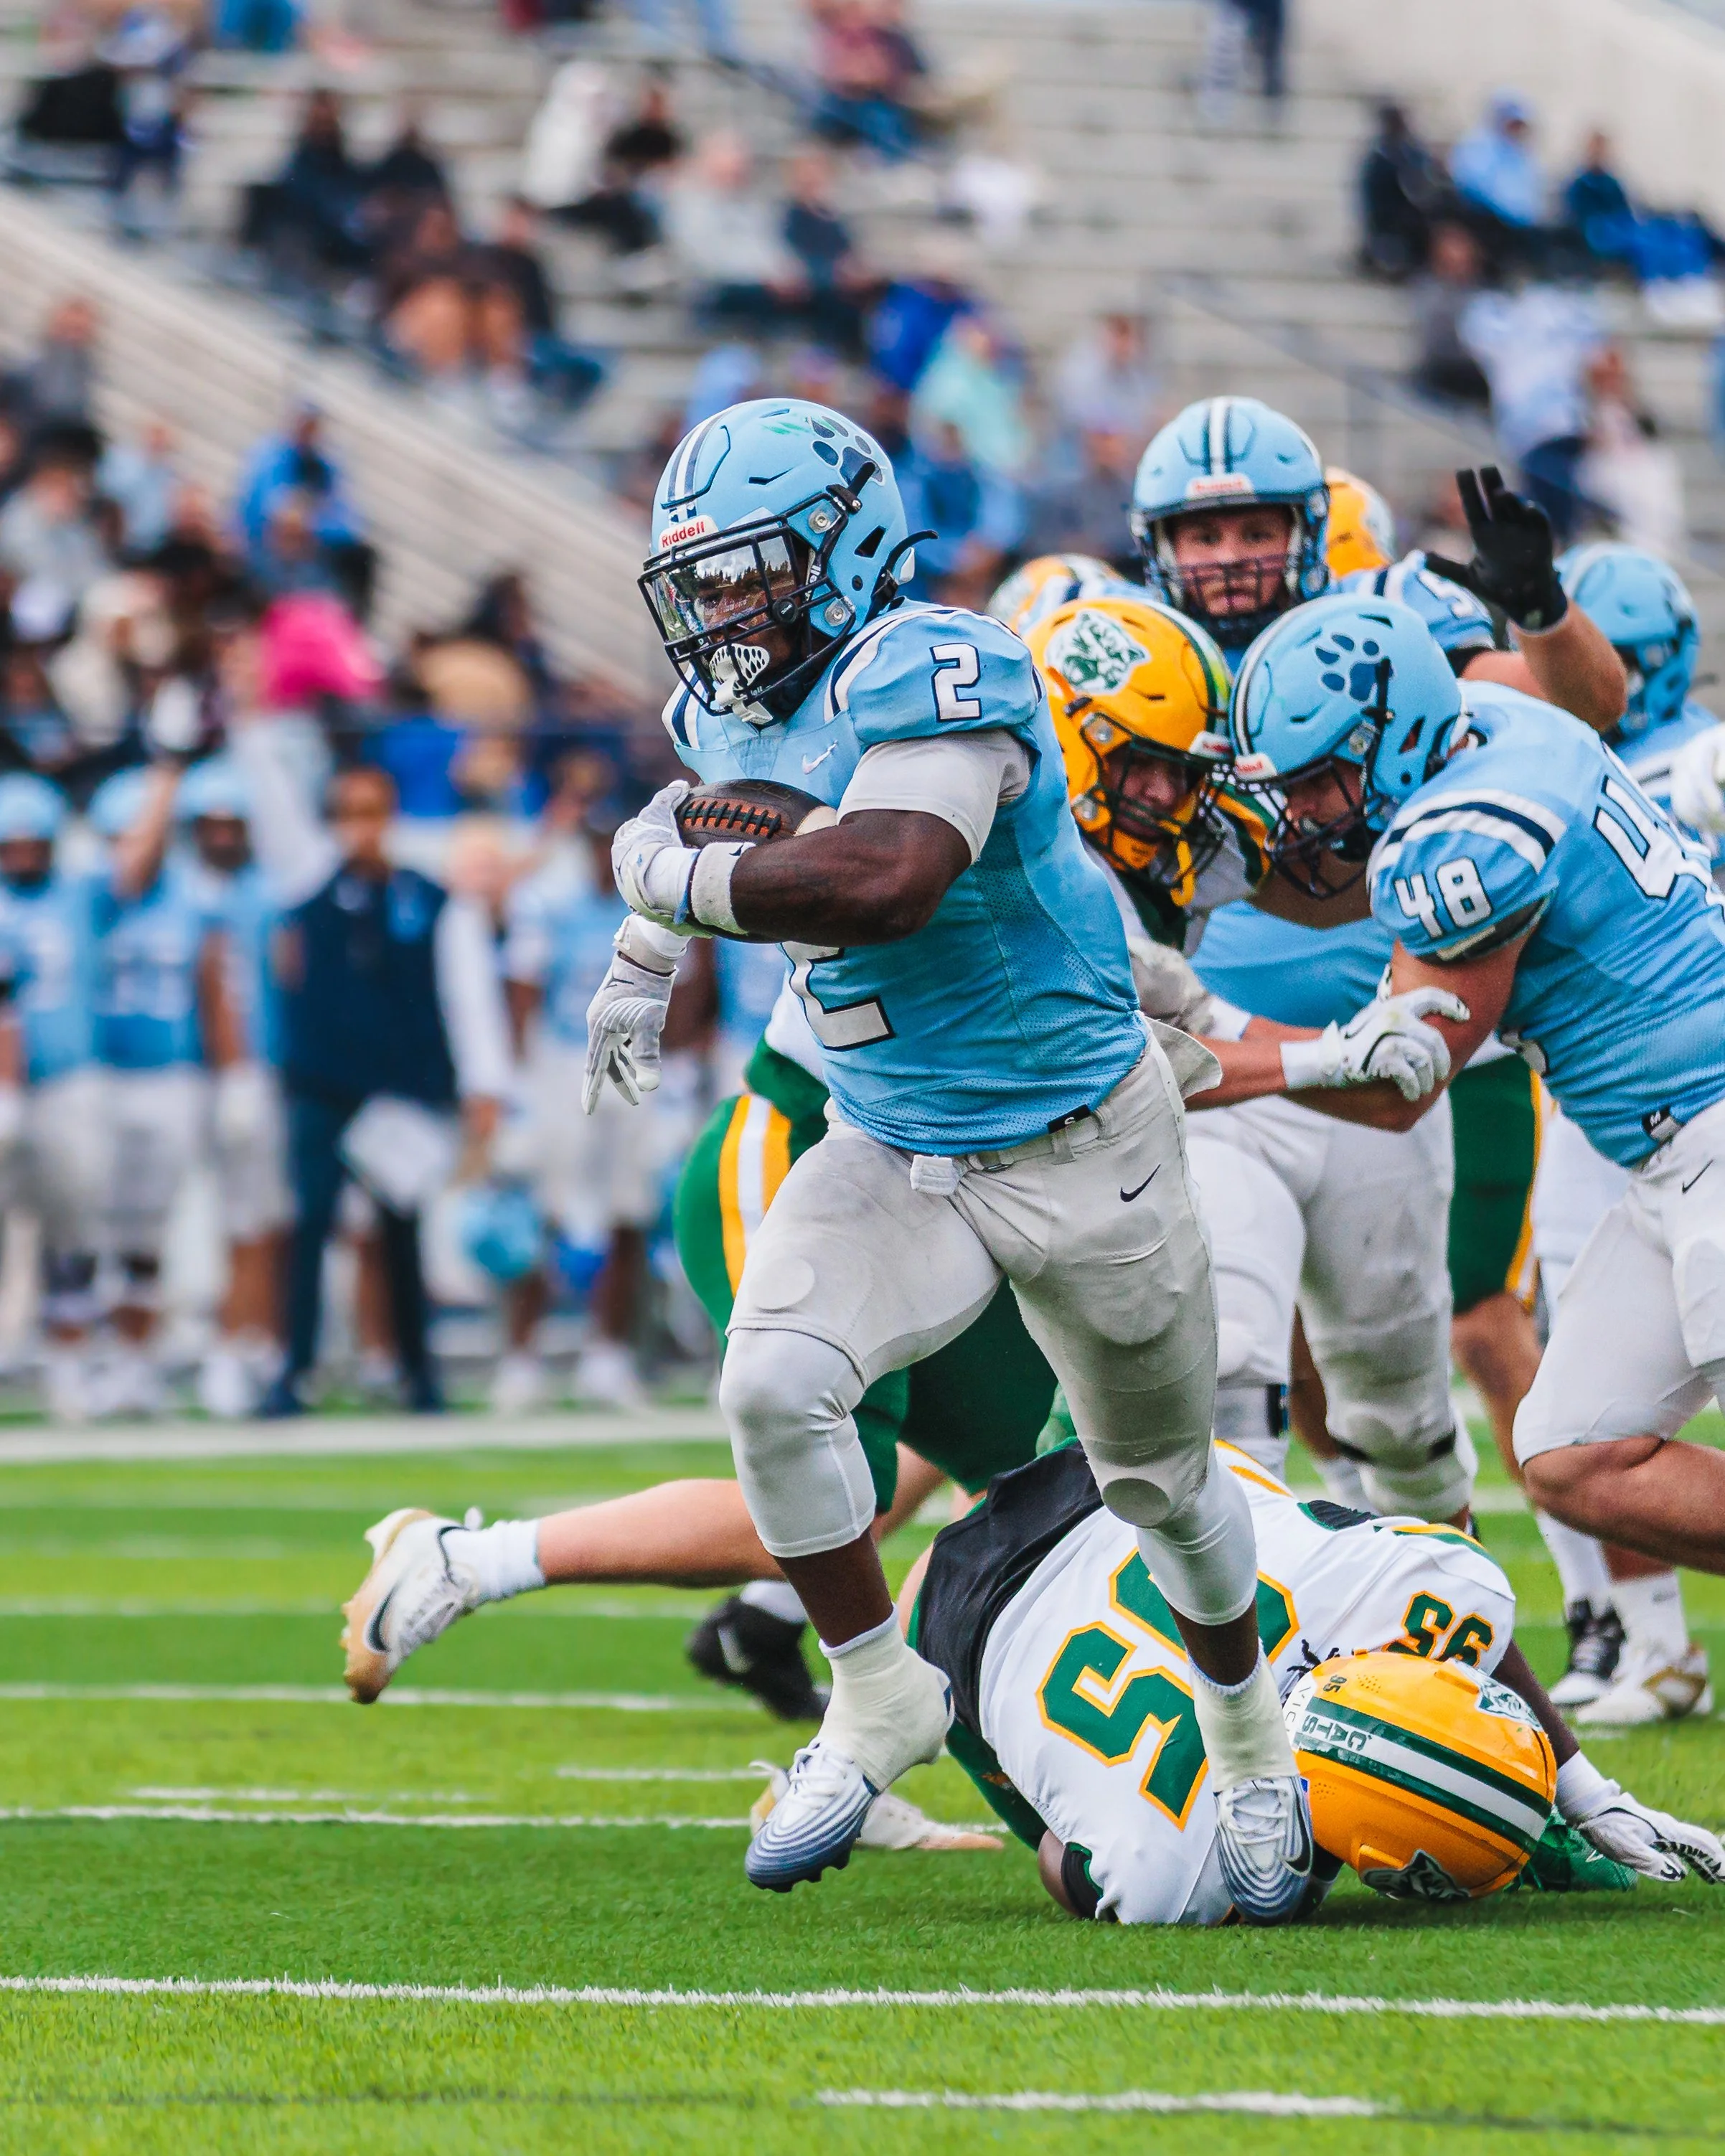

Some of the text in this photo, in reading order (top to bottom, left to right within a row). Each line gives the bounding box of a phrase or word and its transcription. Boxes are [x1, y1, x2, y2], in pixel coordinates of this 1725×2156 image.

[662, 521, 705, 547] Riddell
[930, 643, 982, 722] 2
[1591, 761, 1725, 904] 4
[1394, 857, 1494, 938] 48
[1322, 1675, 1348, 1693] 95
